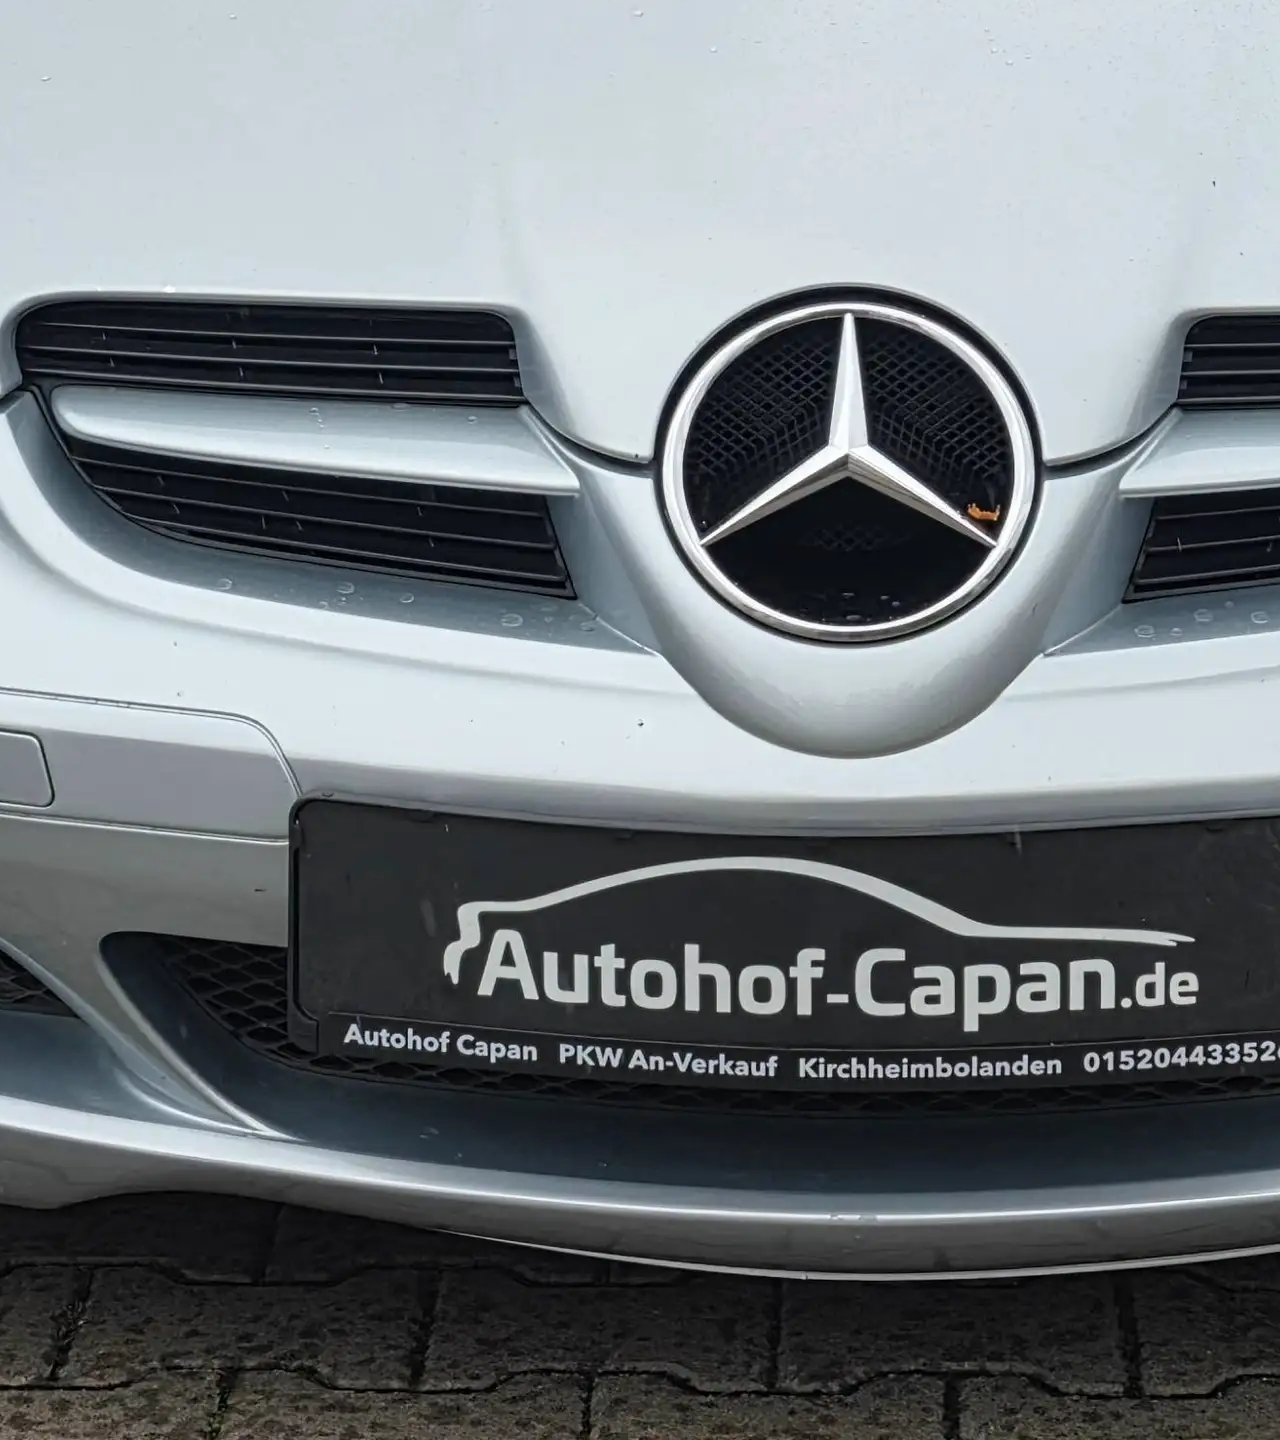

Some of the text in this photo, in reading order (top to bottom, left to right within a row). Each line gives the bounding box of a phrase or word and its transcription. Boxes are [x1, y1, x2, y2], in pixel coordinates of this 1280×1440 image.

[477, 929, 1199, 1032] Autohof-Capan.de
[343, 1023, 451, 1053] Autohof
[456, 1034, 539, 1064] Capan
[559, 1043, 624, 1068] PKW
[628, 1049, 779, 1078] An-Verkauf
[799, 1055, 1063, 1080] Kirchheimbolanden
